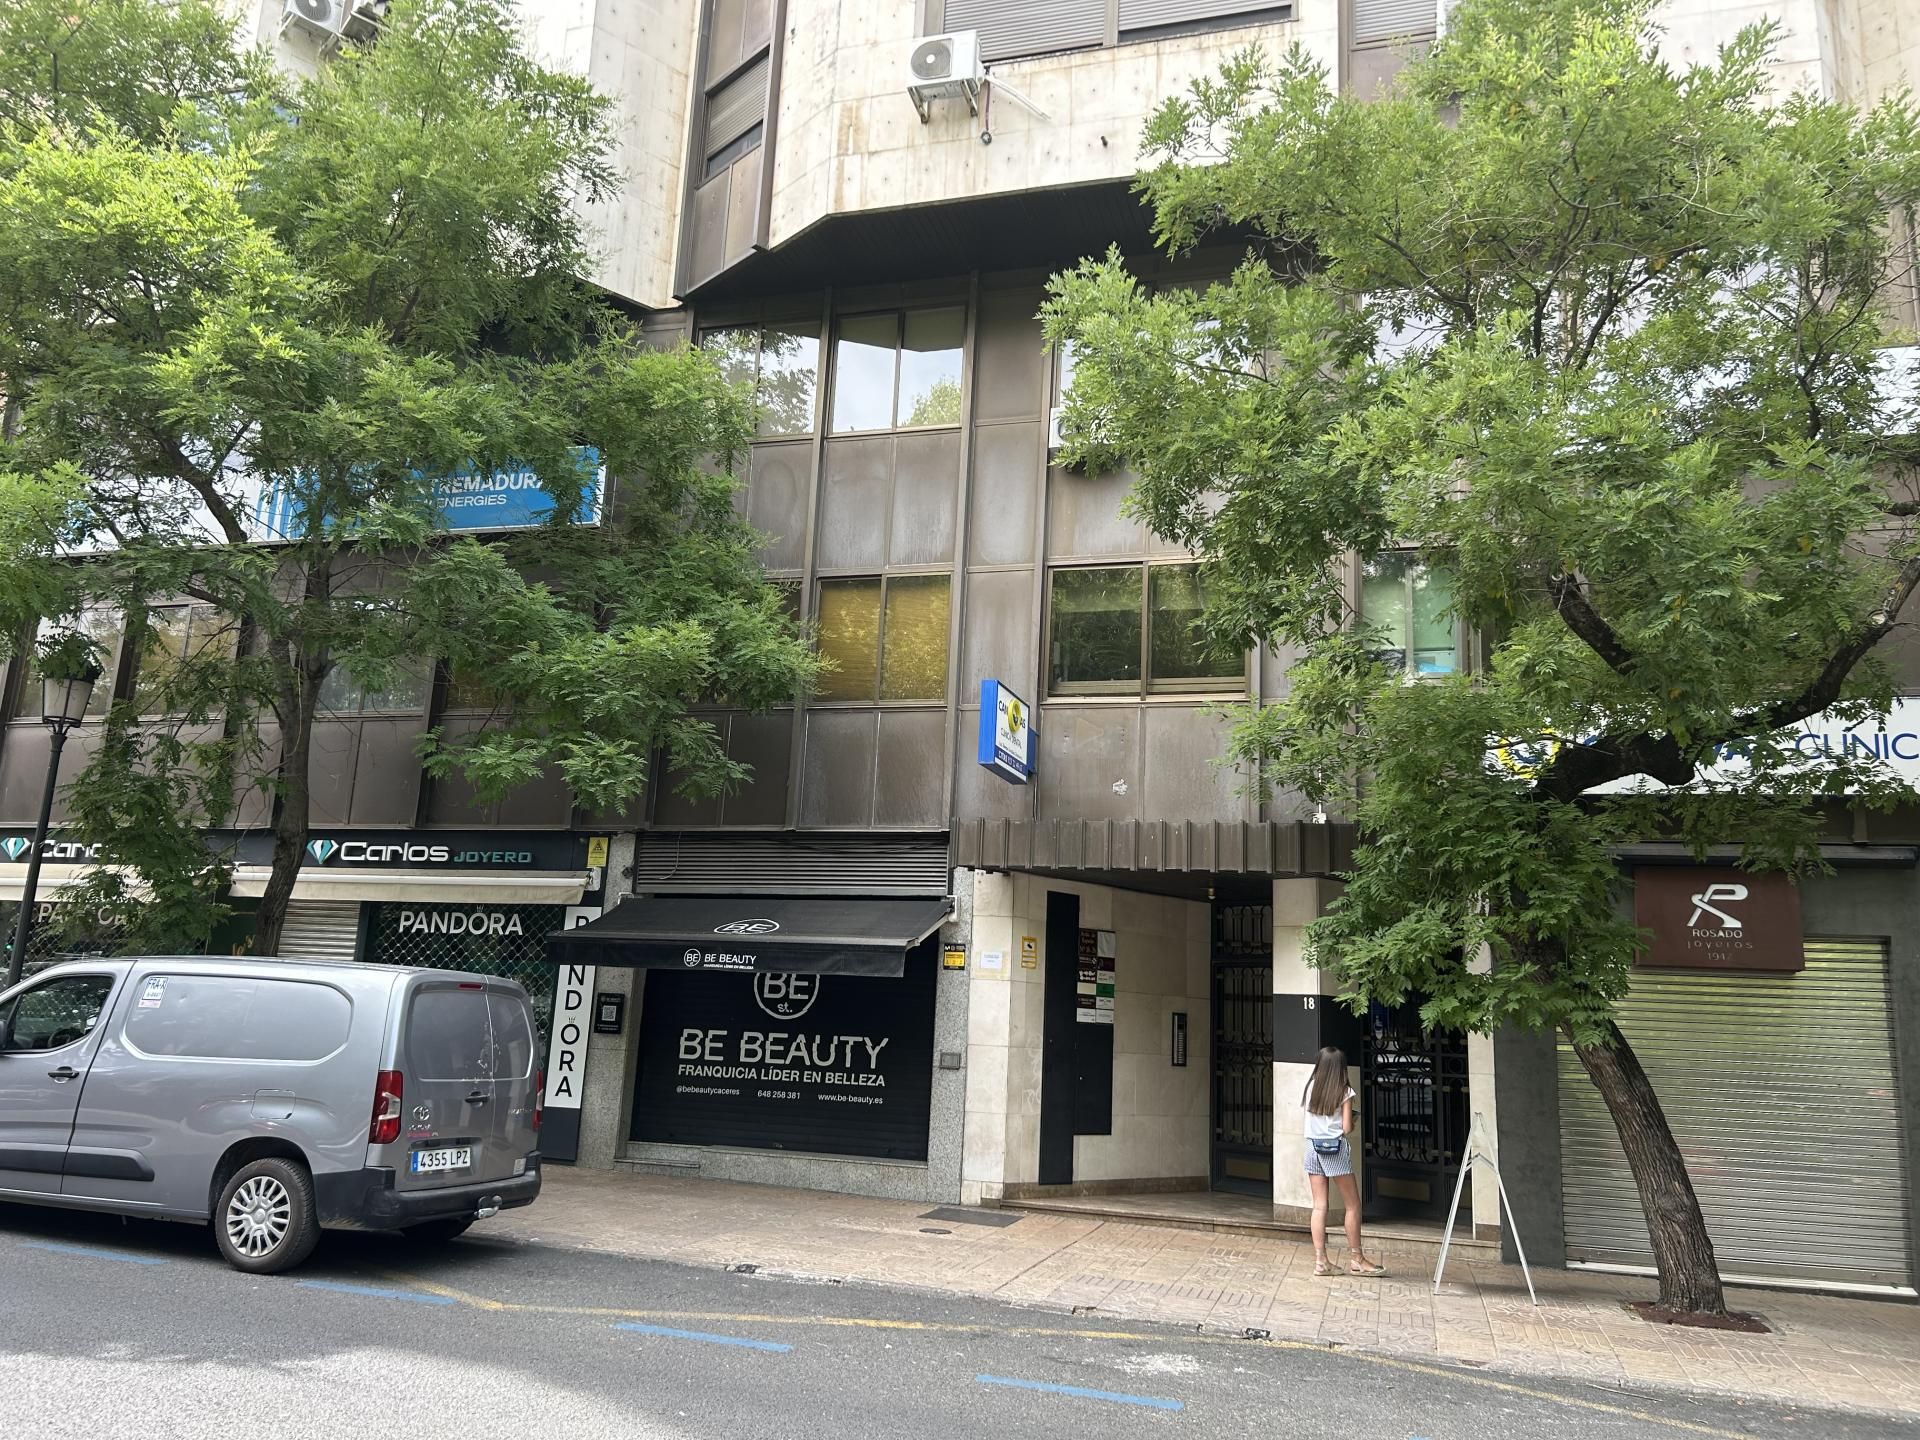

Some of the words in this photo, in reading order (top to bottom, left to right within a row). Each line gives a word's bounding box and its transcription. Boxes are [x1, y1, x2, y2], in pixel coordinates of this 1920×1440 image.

[340, 841, 449, 862] Carlos
[453, 851, 533, 863] JOYERO
[399, 911, 523, 936] PANDORA
[1692, 928, 1743, 939] ROSADO
[686, 953, 699, 963] BE
[704, 953, 717, 963] BE
[719, 953, 757, 965] BEAUTY
[763, 972, 809, 1000] BE
[776, 1001, 793, 1013] st.
[1303, 996, 1315, 1010] 18
[679, 1028, 728, 1062] BE
[739, 1031, 890, 1069] BEAUTY
[677, 1064, 758, 1080] FRANQUICIA
[760, 1066, 800, 1082] LÍDER
[803, 1070, 822, 1083] EN
[825, 1072, 886, 1087] BELLEZA
[757, 1089, 771, 1098] 648
[419, 1151, 447, 1168] 4355
[450, 1150, 468, 1166] LPZ
